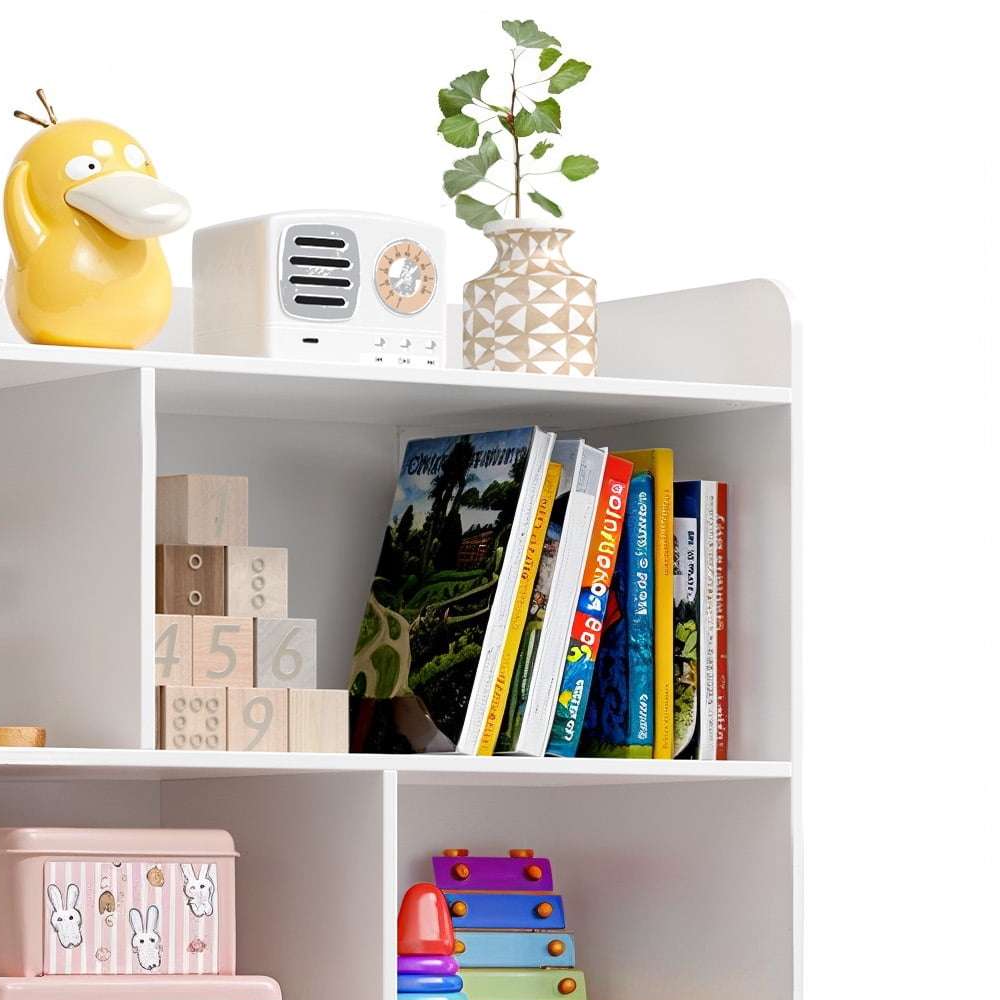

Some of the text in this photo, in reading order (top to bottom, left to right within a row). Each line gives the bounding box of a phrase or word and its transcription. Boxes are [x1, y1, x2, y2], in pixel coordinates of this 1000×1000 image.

[206, 483, 230, 539] 1
[155, 623, 180, 679] 4
[206, 624, 241, 680] 5
[271, 625, 304, 681] 6
[242, 696, 274, 751] 9
